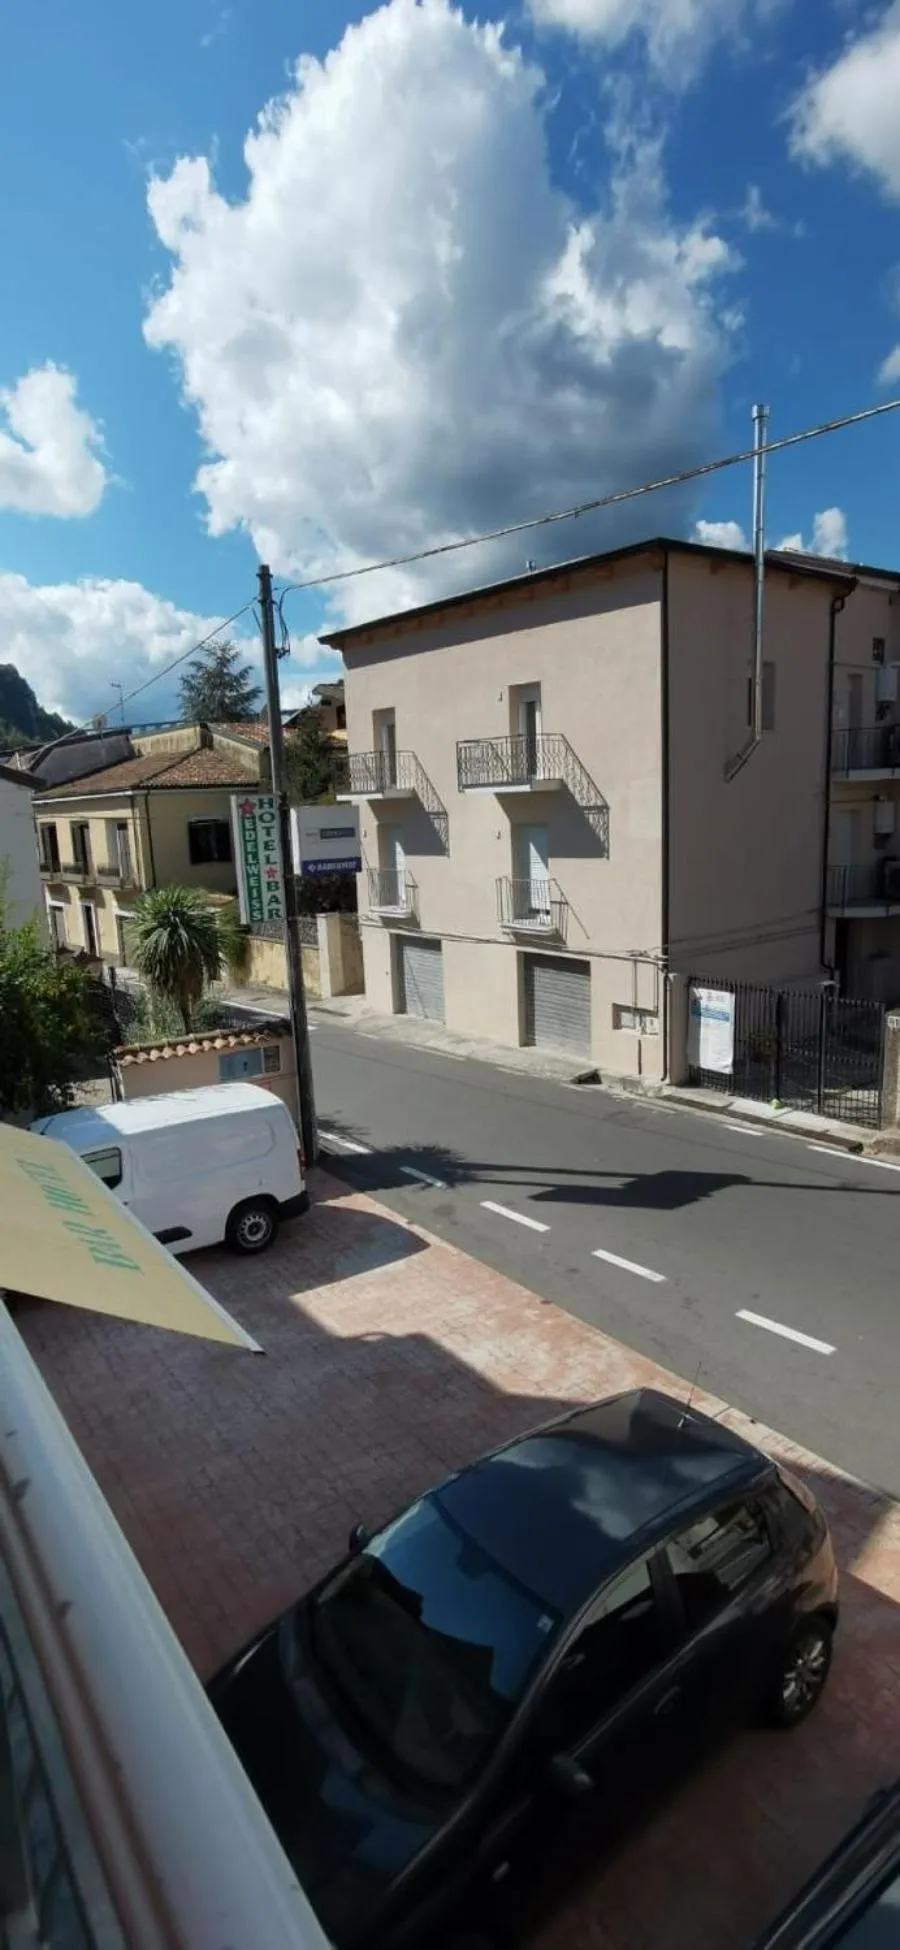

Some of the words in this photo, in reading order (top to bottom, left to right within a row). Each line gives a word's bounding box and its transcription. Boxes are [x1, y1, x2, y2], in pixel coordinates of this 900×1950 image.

[258, 798, 277, 865] HOTEL
[244, 818, 262, 920] EDELWEISS
[266, 881, 282, 920] BAR
